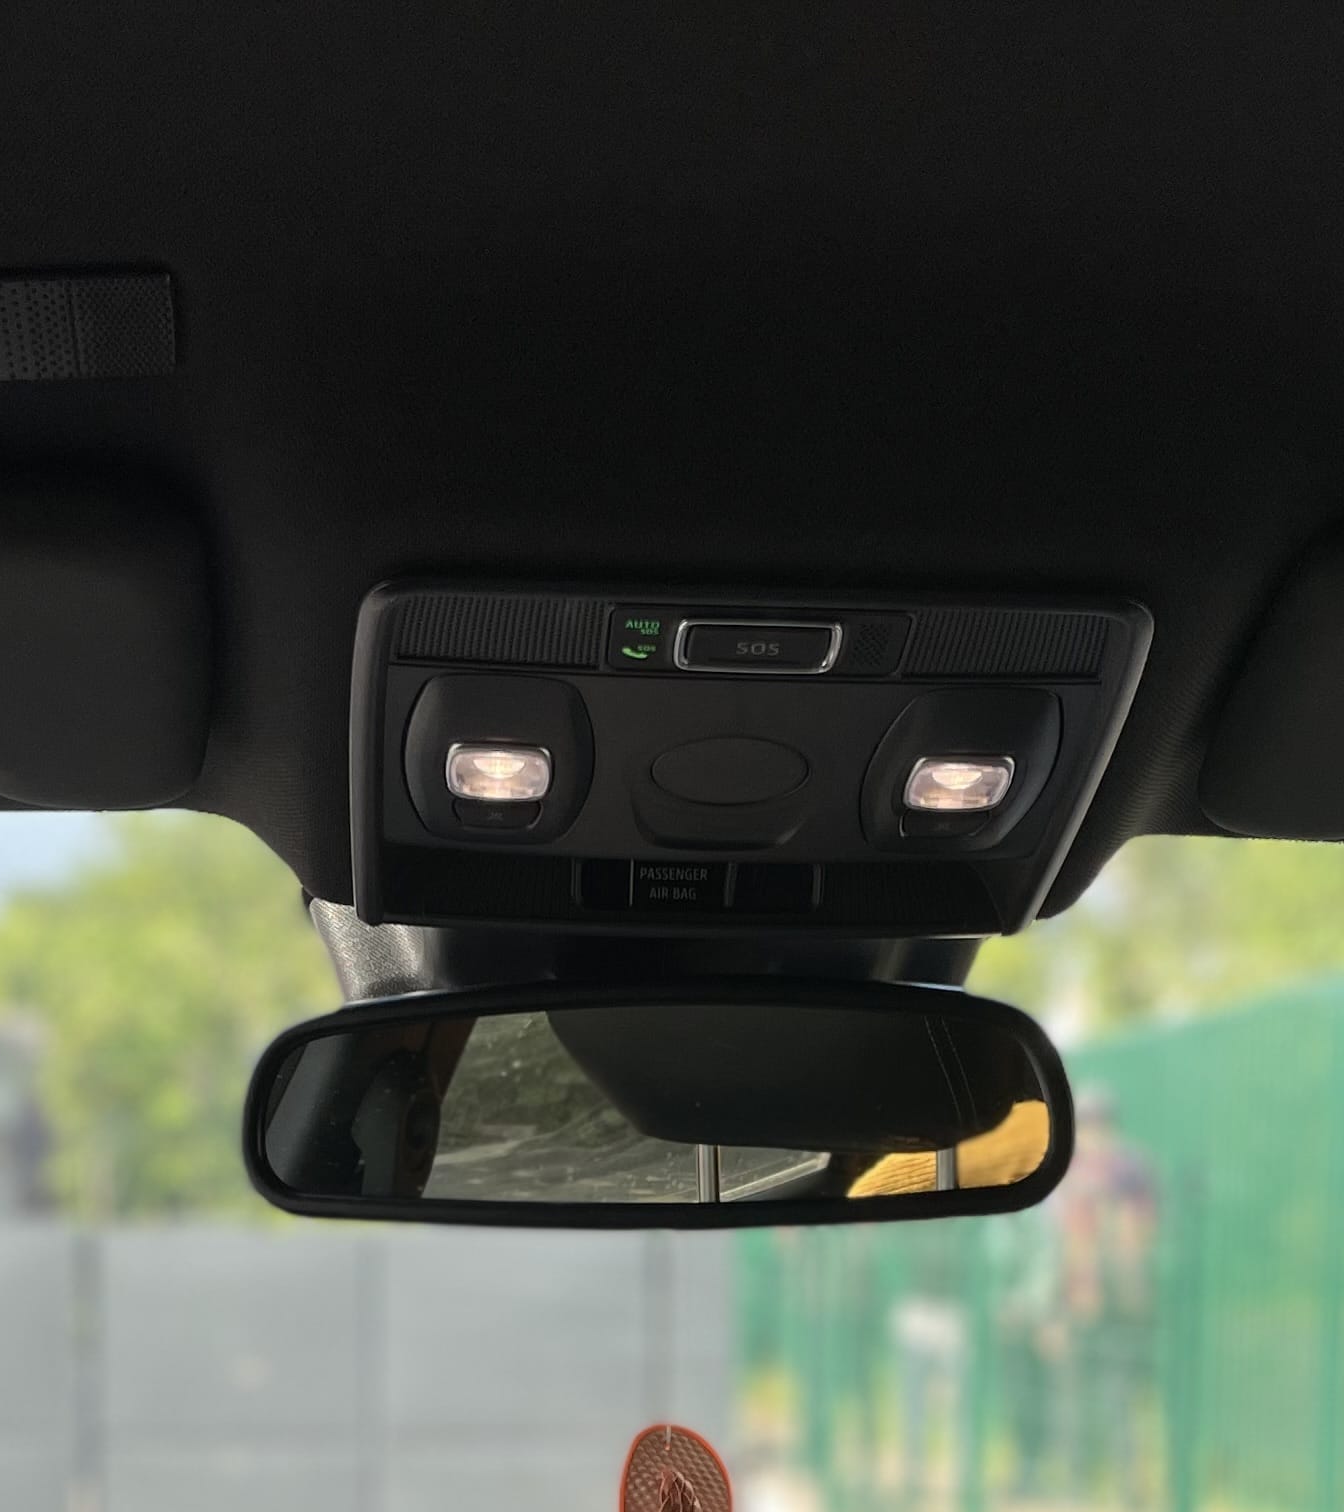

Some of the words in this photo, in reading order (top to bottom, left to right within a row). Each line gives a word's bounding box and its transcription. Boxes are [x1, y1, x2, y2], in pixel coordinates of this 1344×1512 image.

[625, 619, 660, 630] AUTO
[736, 641, 780, 656] SOS
[639, 867, 708, 881] PASSENGER
[649, 887, 669, 900] AIR
[672, 887, 697, 900] BAG
